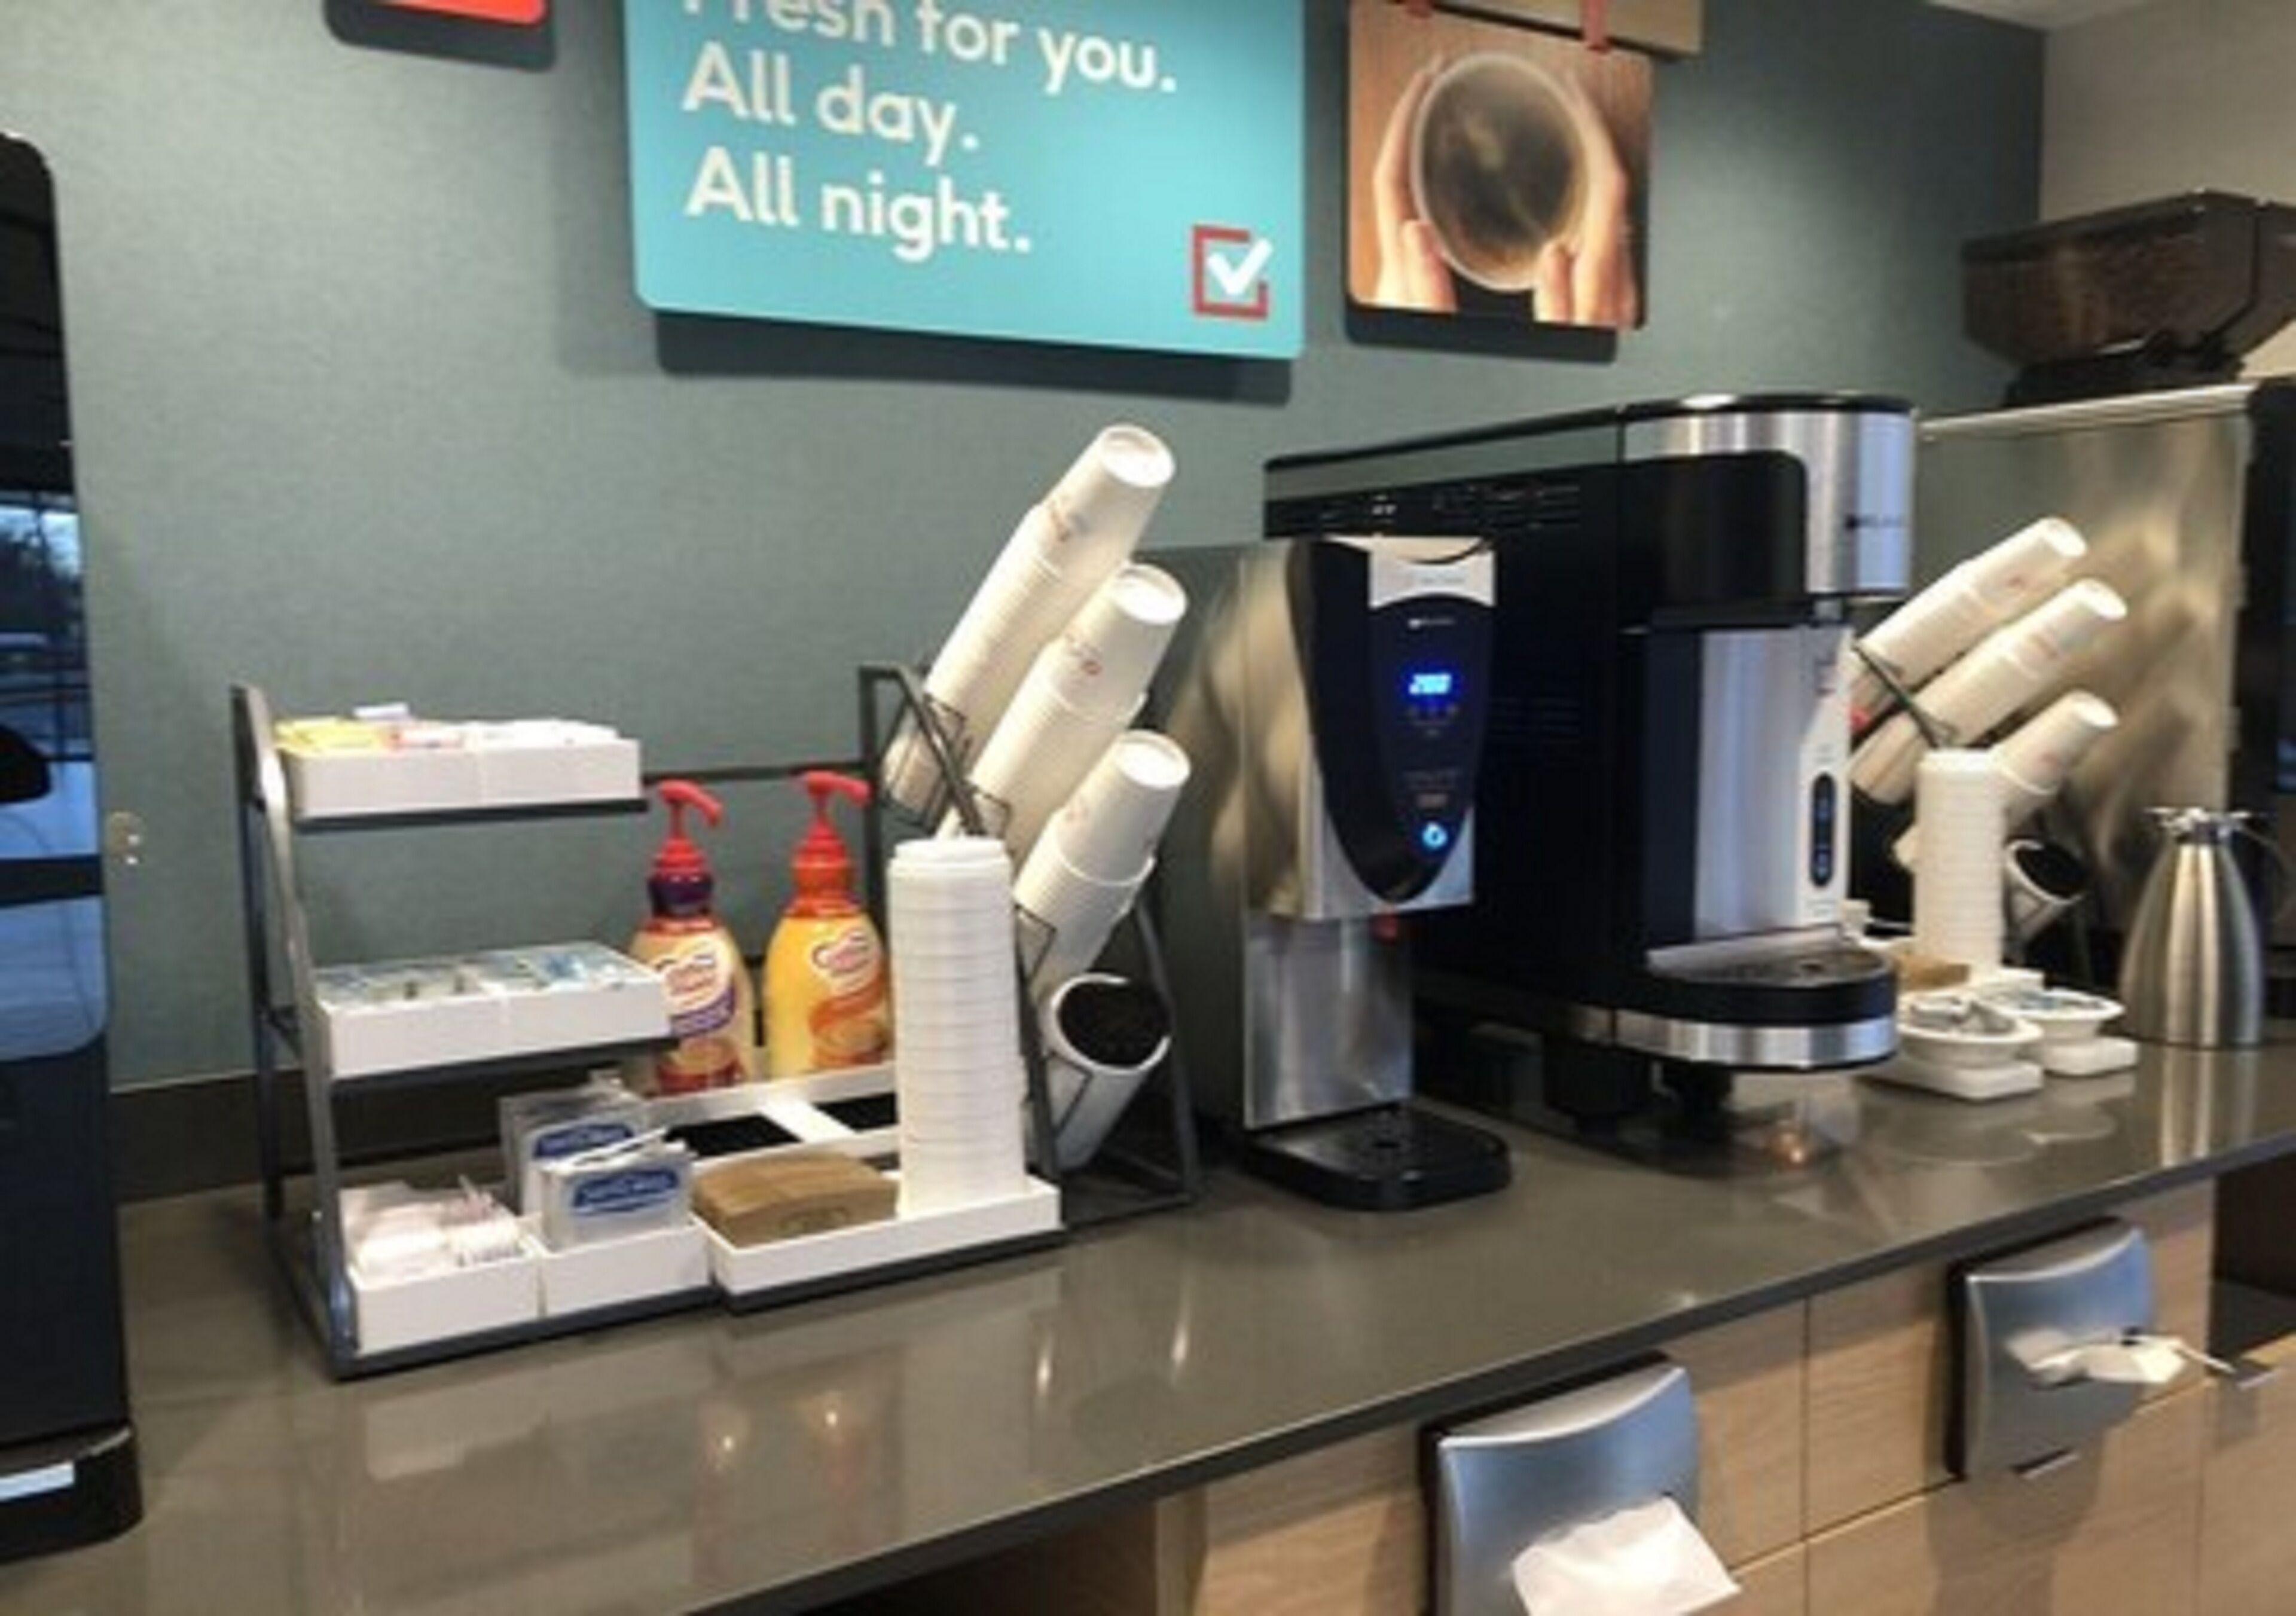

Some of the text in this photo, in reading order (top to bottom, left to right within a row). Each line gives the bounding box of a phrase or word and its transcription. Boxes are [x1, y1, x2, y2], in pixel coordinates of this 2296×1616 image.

[682, 42, 979, 168] All day.
[685, 0, 1177, 96] esh for you.
[684, 145, 1031, 263] All night.
